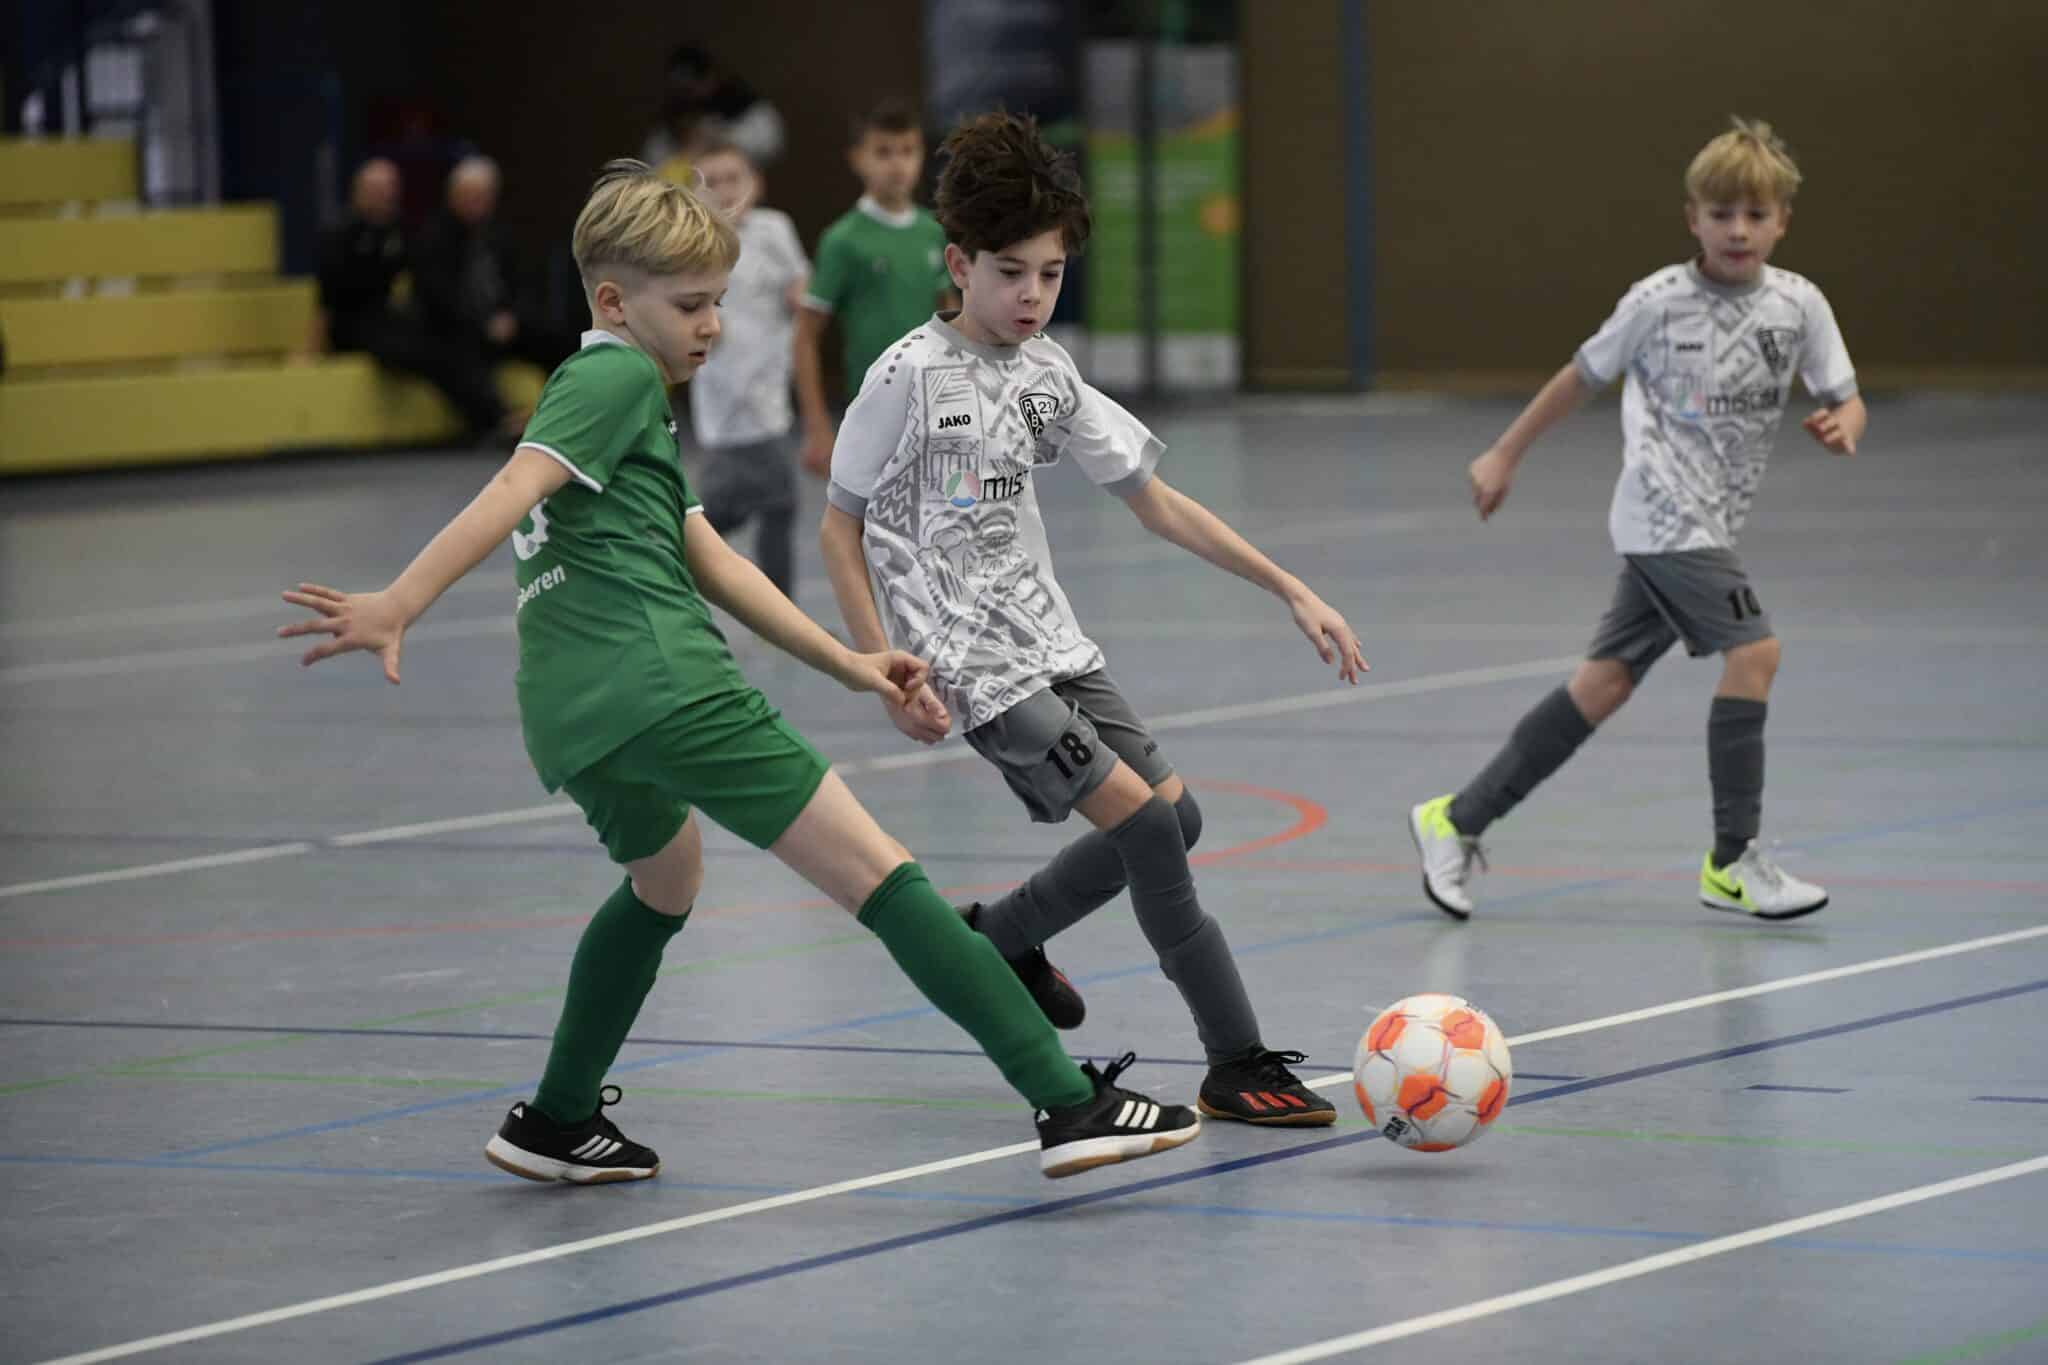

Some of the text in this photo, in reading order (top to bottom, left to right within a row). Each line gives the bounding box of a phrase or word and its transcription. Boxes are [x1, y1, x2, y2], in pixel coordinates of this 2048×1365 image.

[937, 414, 971, 429] JAKO
[983, 469, 1029, 500] mis
[1046, 731, 1092, 779] 18
